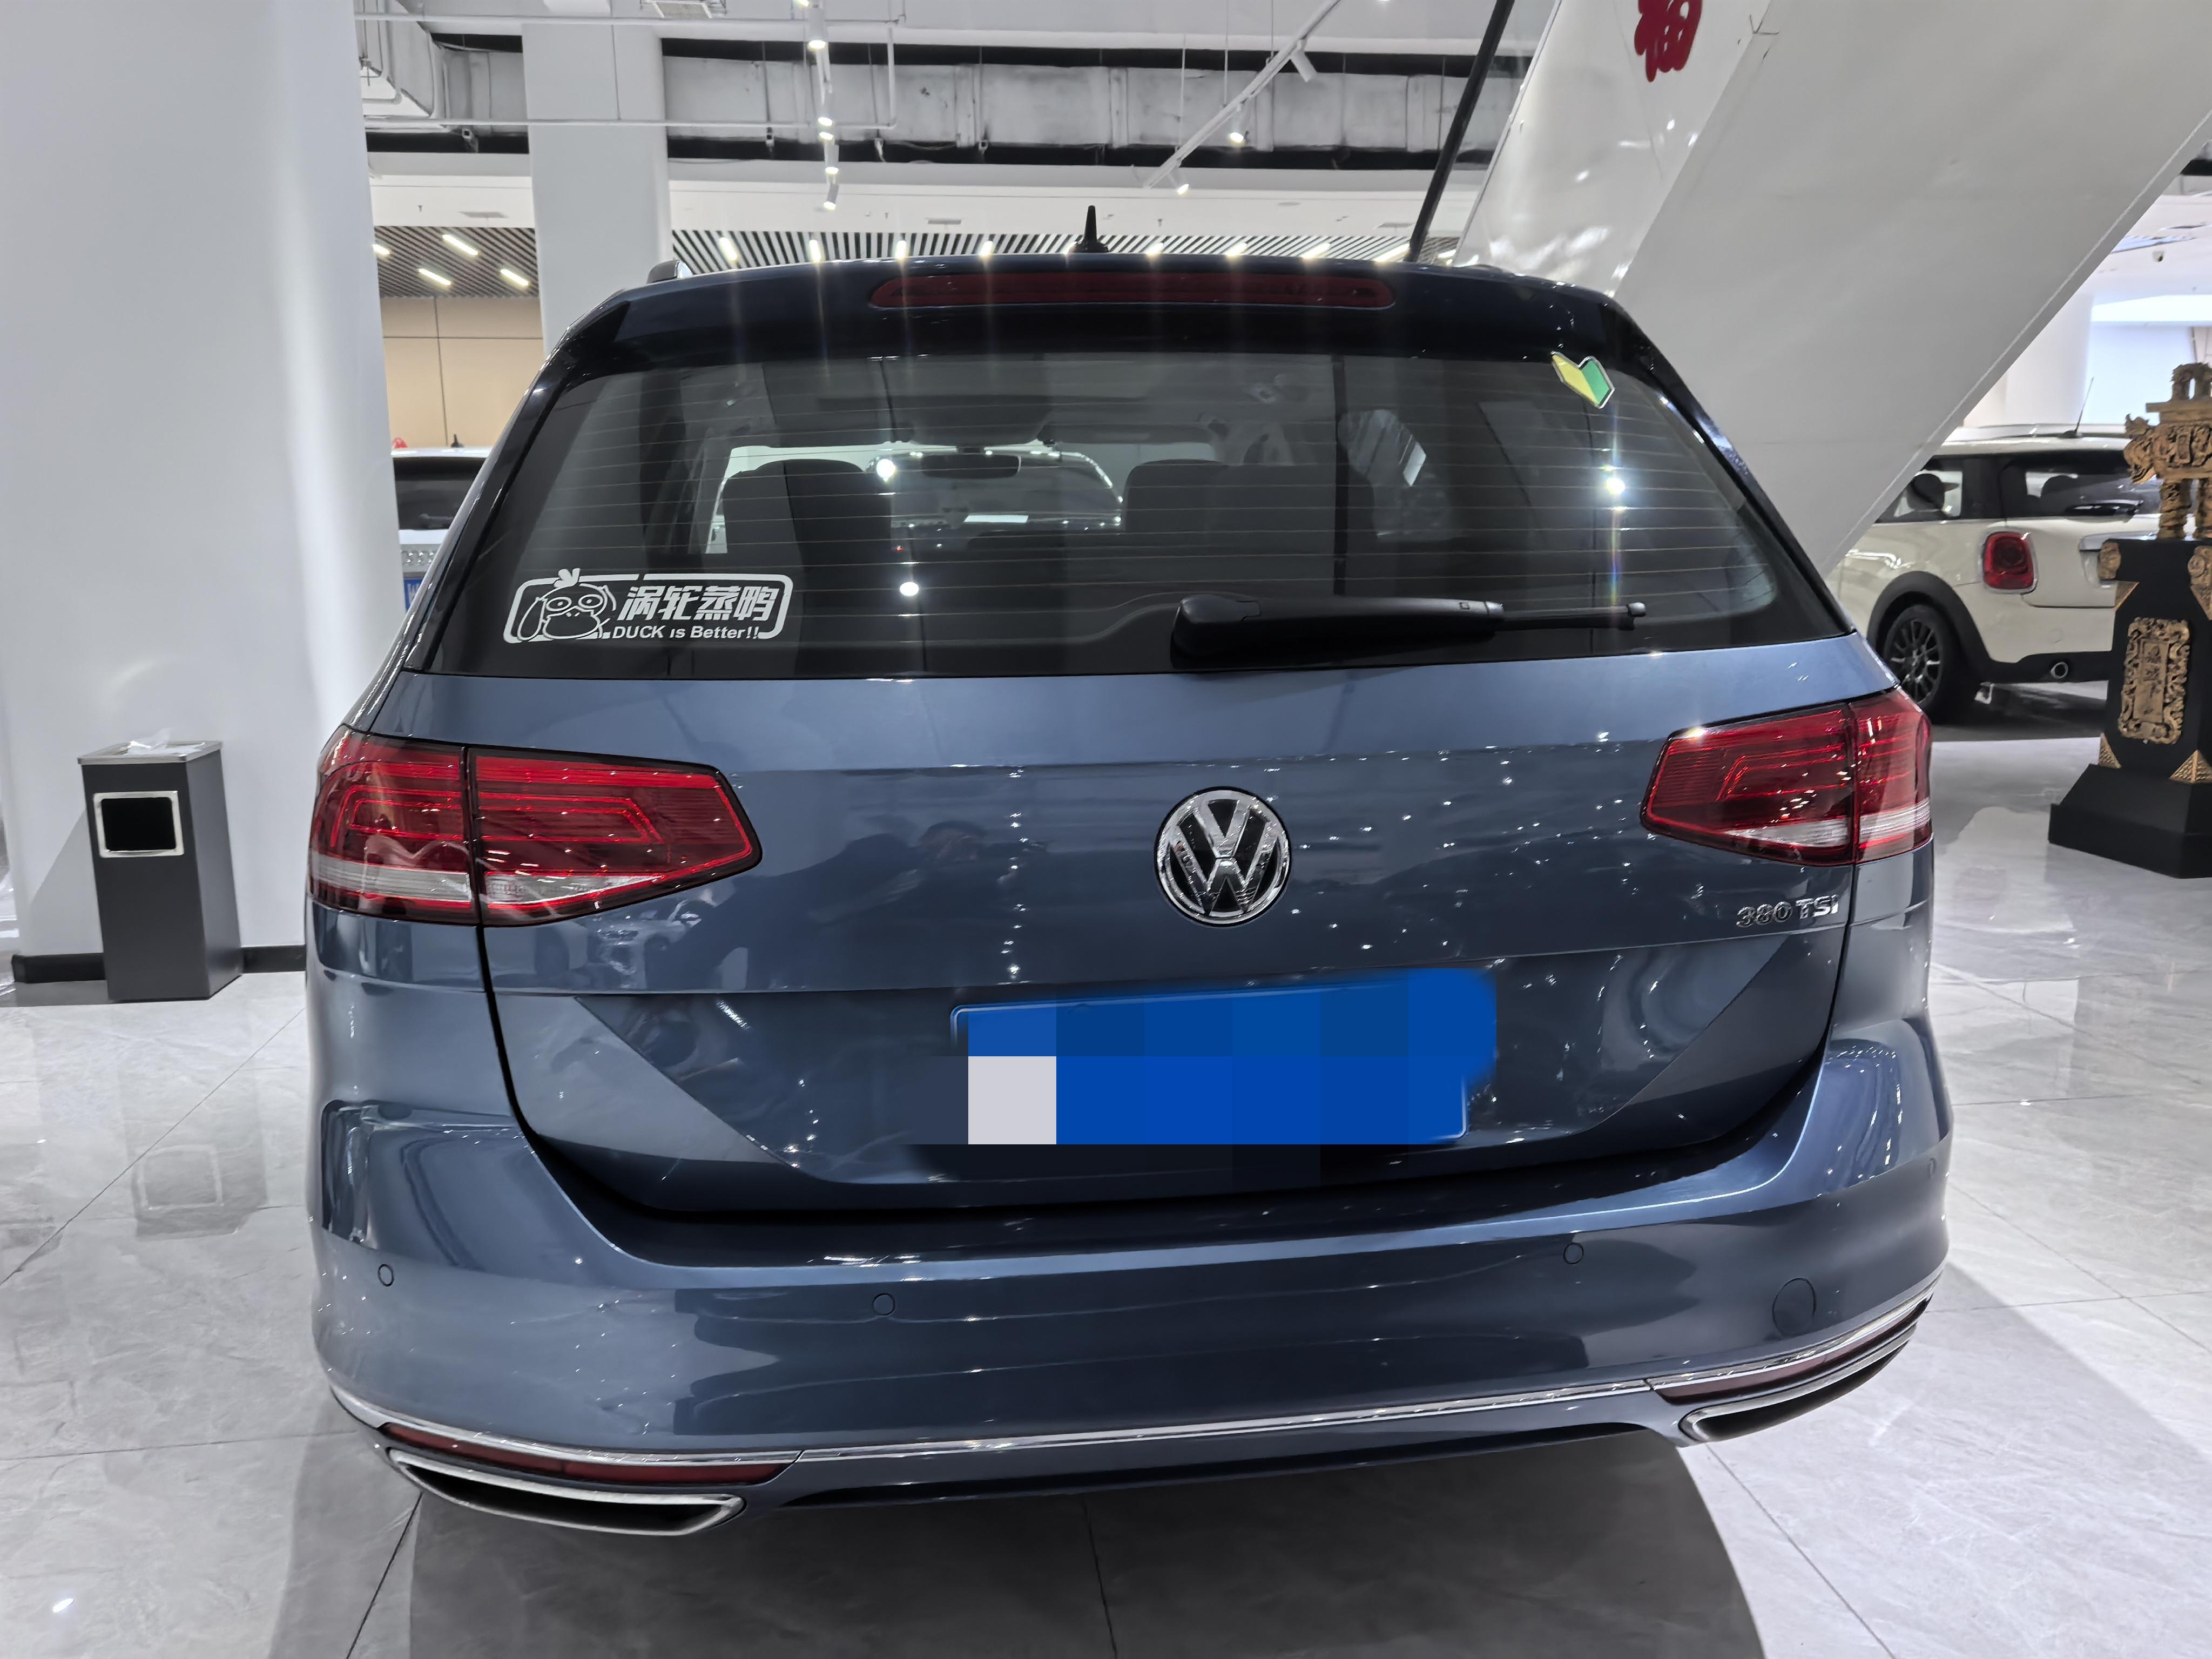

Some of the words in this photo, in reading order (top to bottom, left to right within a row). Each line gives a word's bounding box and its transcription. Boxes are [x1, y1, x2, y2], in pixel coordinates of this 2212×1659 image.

[612, 625, 665, 639] DUCK
[670, 628, 686, 639] is
[690, 625, 759, 639] Better!!
